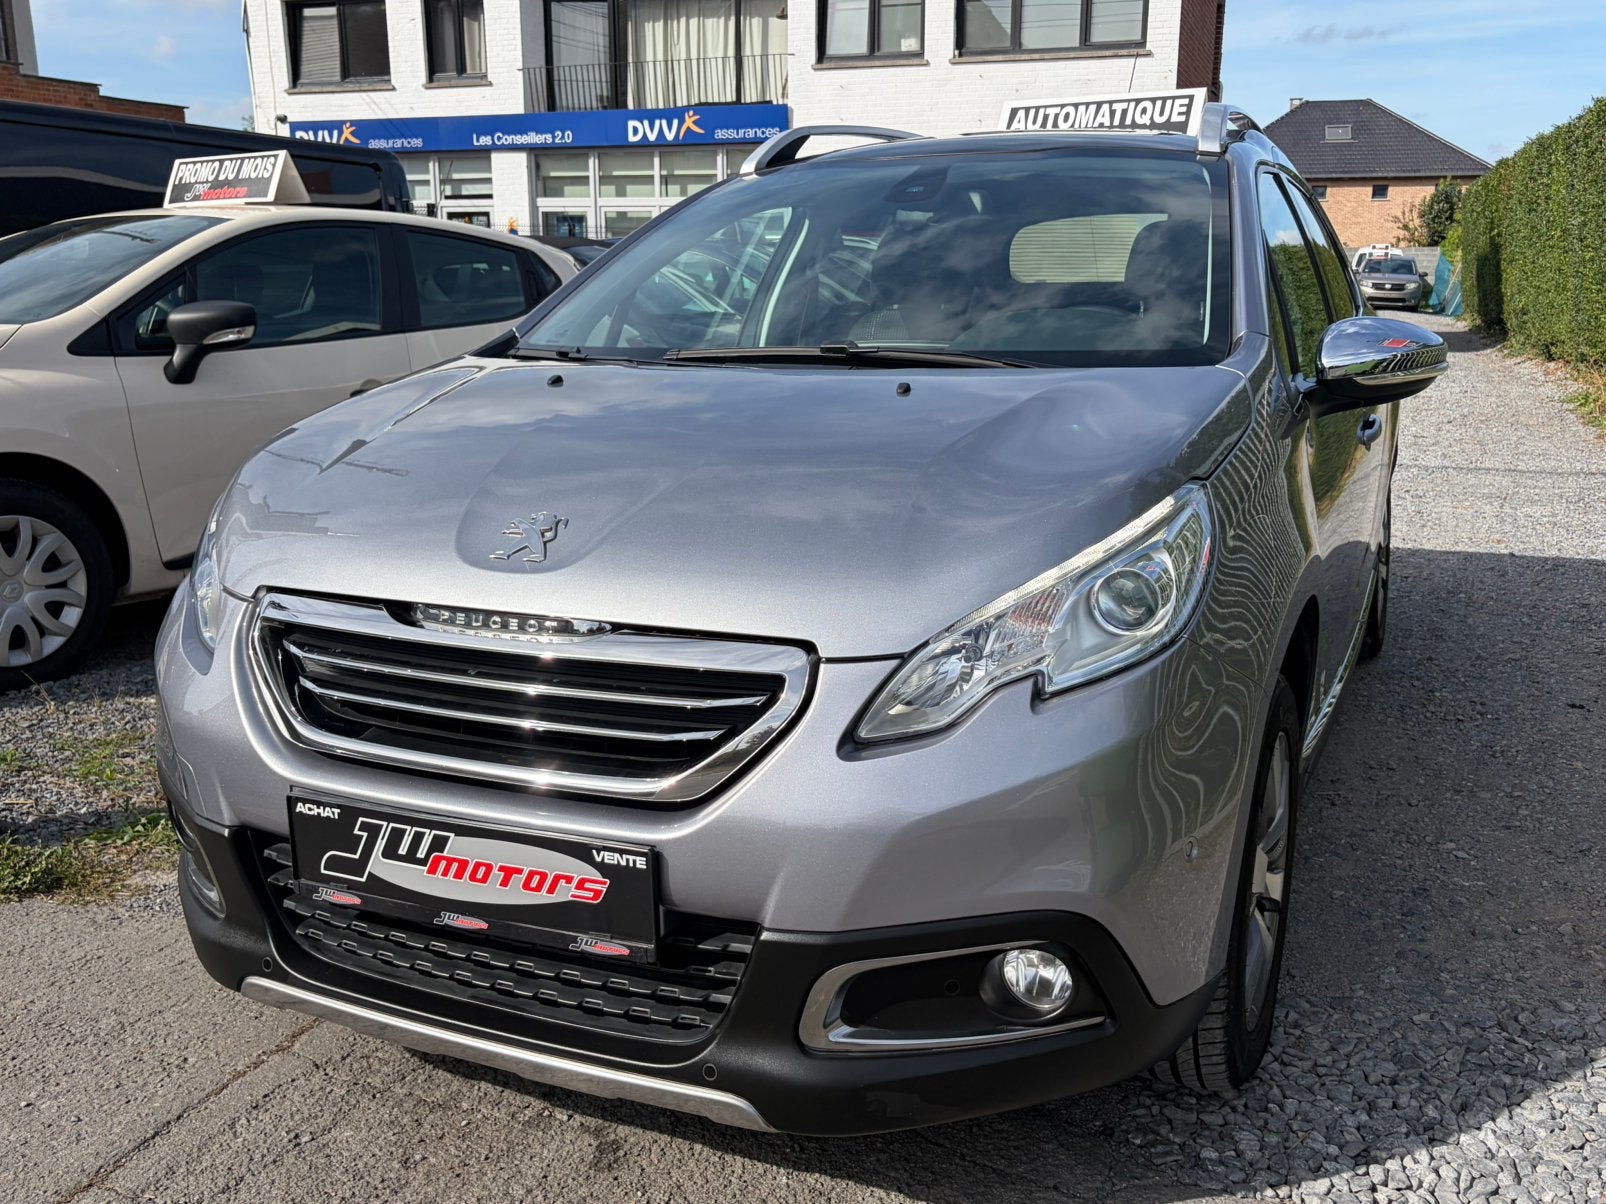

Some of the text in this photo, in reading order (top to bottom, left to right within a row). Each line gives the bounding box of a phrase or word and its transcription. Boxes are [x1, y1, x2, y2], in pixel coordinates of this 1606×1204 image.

[1010, 98, 1189, 130] AUTOMATIQUE
[472, 130, 573, 146] Les Conseillers 2.0
[627, 118, 780, 142] DVV assurances
[368, 137, 423, 149] assurances
[174, 156, 275, 185] PROMO DU MOIS
[438, 608, 558, 634] PEUGEOT
[295, 802, 340, 820] ACHAT
[592, 850, 647, 869] VENTE
